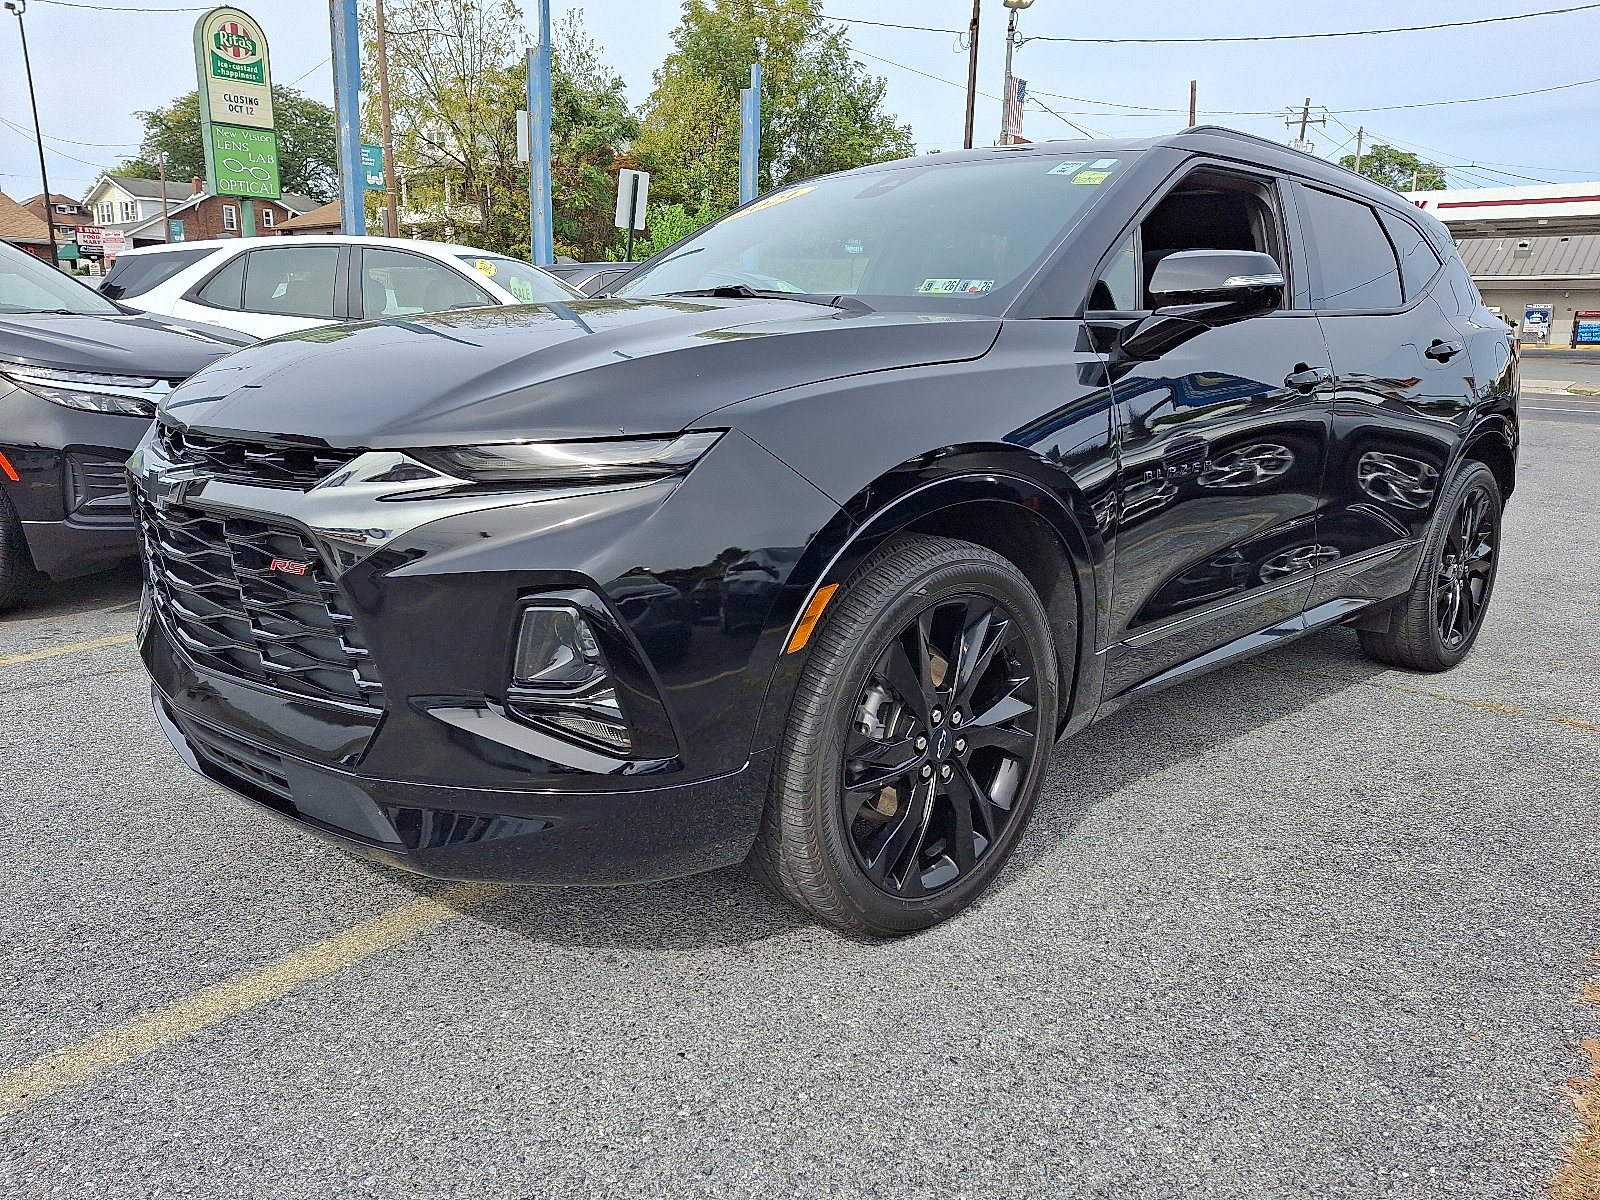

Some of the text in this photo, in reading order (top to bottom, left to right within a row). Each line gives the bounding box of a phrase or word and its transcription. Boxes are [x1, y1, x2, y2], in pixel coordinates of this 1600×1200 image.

[219, 30, 253, 50] Rita's
[232, 62, 259, 74] custard
[223, 93, 259, 106] CLOSING
[228, 104, 255, 116] OCT 12
[215, 127, 272, 143] New Vision
[217, 139, 249, 152] LENS
[248, 152, 275, 164] LAB
[219, 179, 277, 195] OPTICAL
[980, 281, 993, 292] 26
[513, 287, 531, 300] SALE
[270, 559, 306, 575] RS
